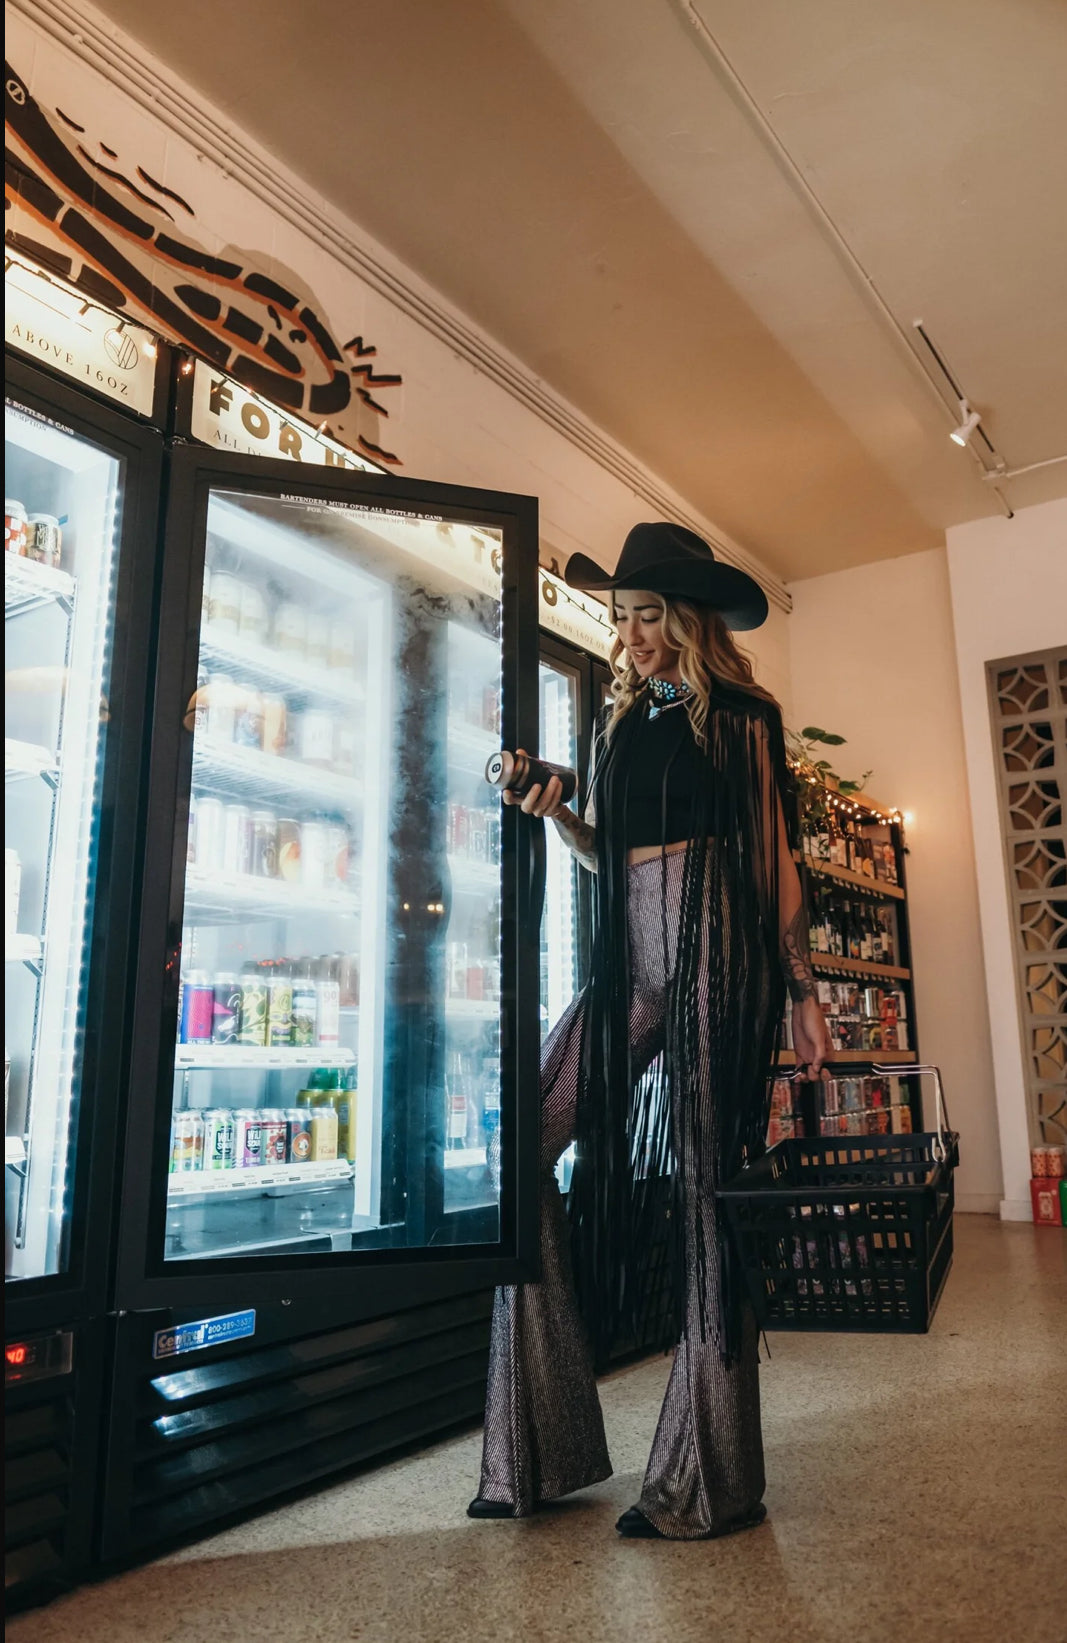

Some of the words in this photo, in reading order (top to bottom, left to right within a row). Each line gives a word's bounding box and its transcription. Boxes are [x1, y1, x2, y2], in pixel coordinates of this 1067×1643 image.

[12, 324, 74, 366] ABOVE
[13, 400, 46, 422] BOTTLES
[47, 418, 54, 426] &
[55, 421, 74, 436] CANS
[210, 379, 303, 462] FOR
[280, 493, 327, 506] BARTENDERS
[328, 500, 348, 509] MUST
[349, 503, 369, 512] OPEN
[370, 506, 384, 514] ALL
[385, 508, 416, 518] BOTTLES
[424, 513, 443, 521] CANS
